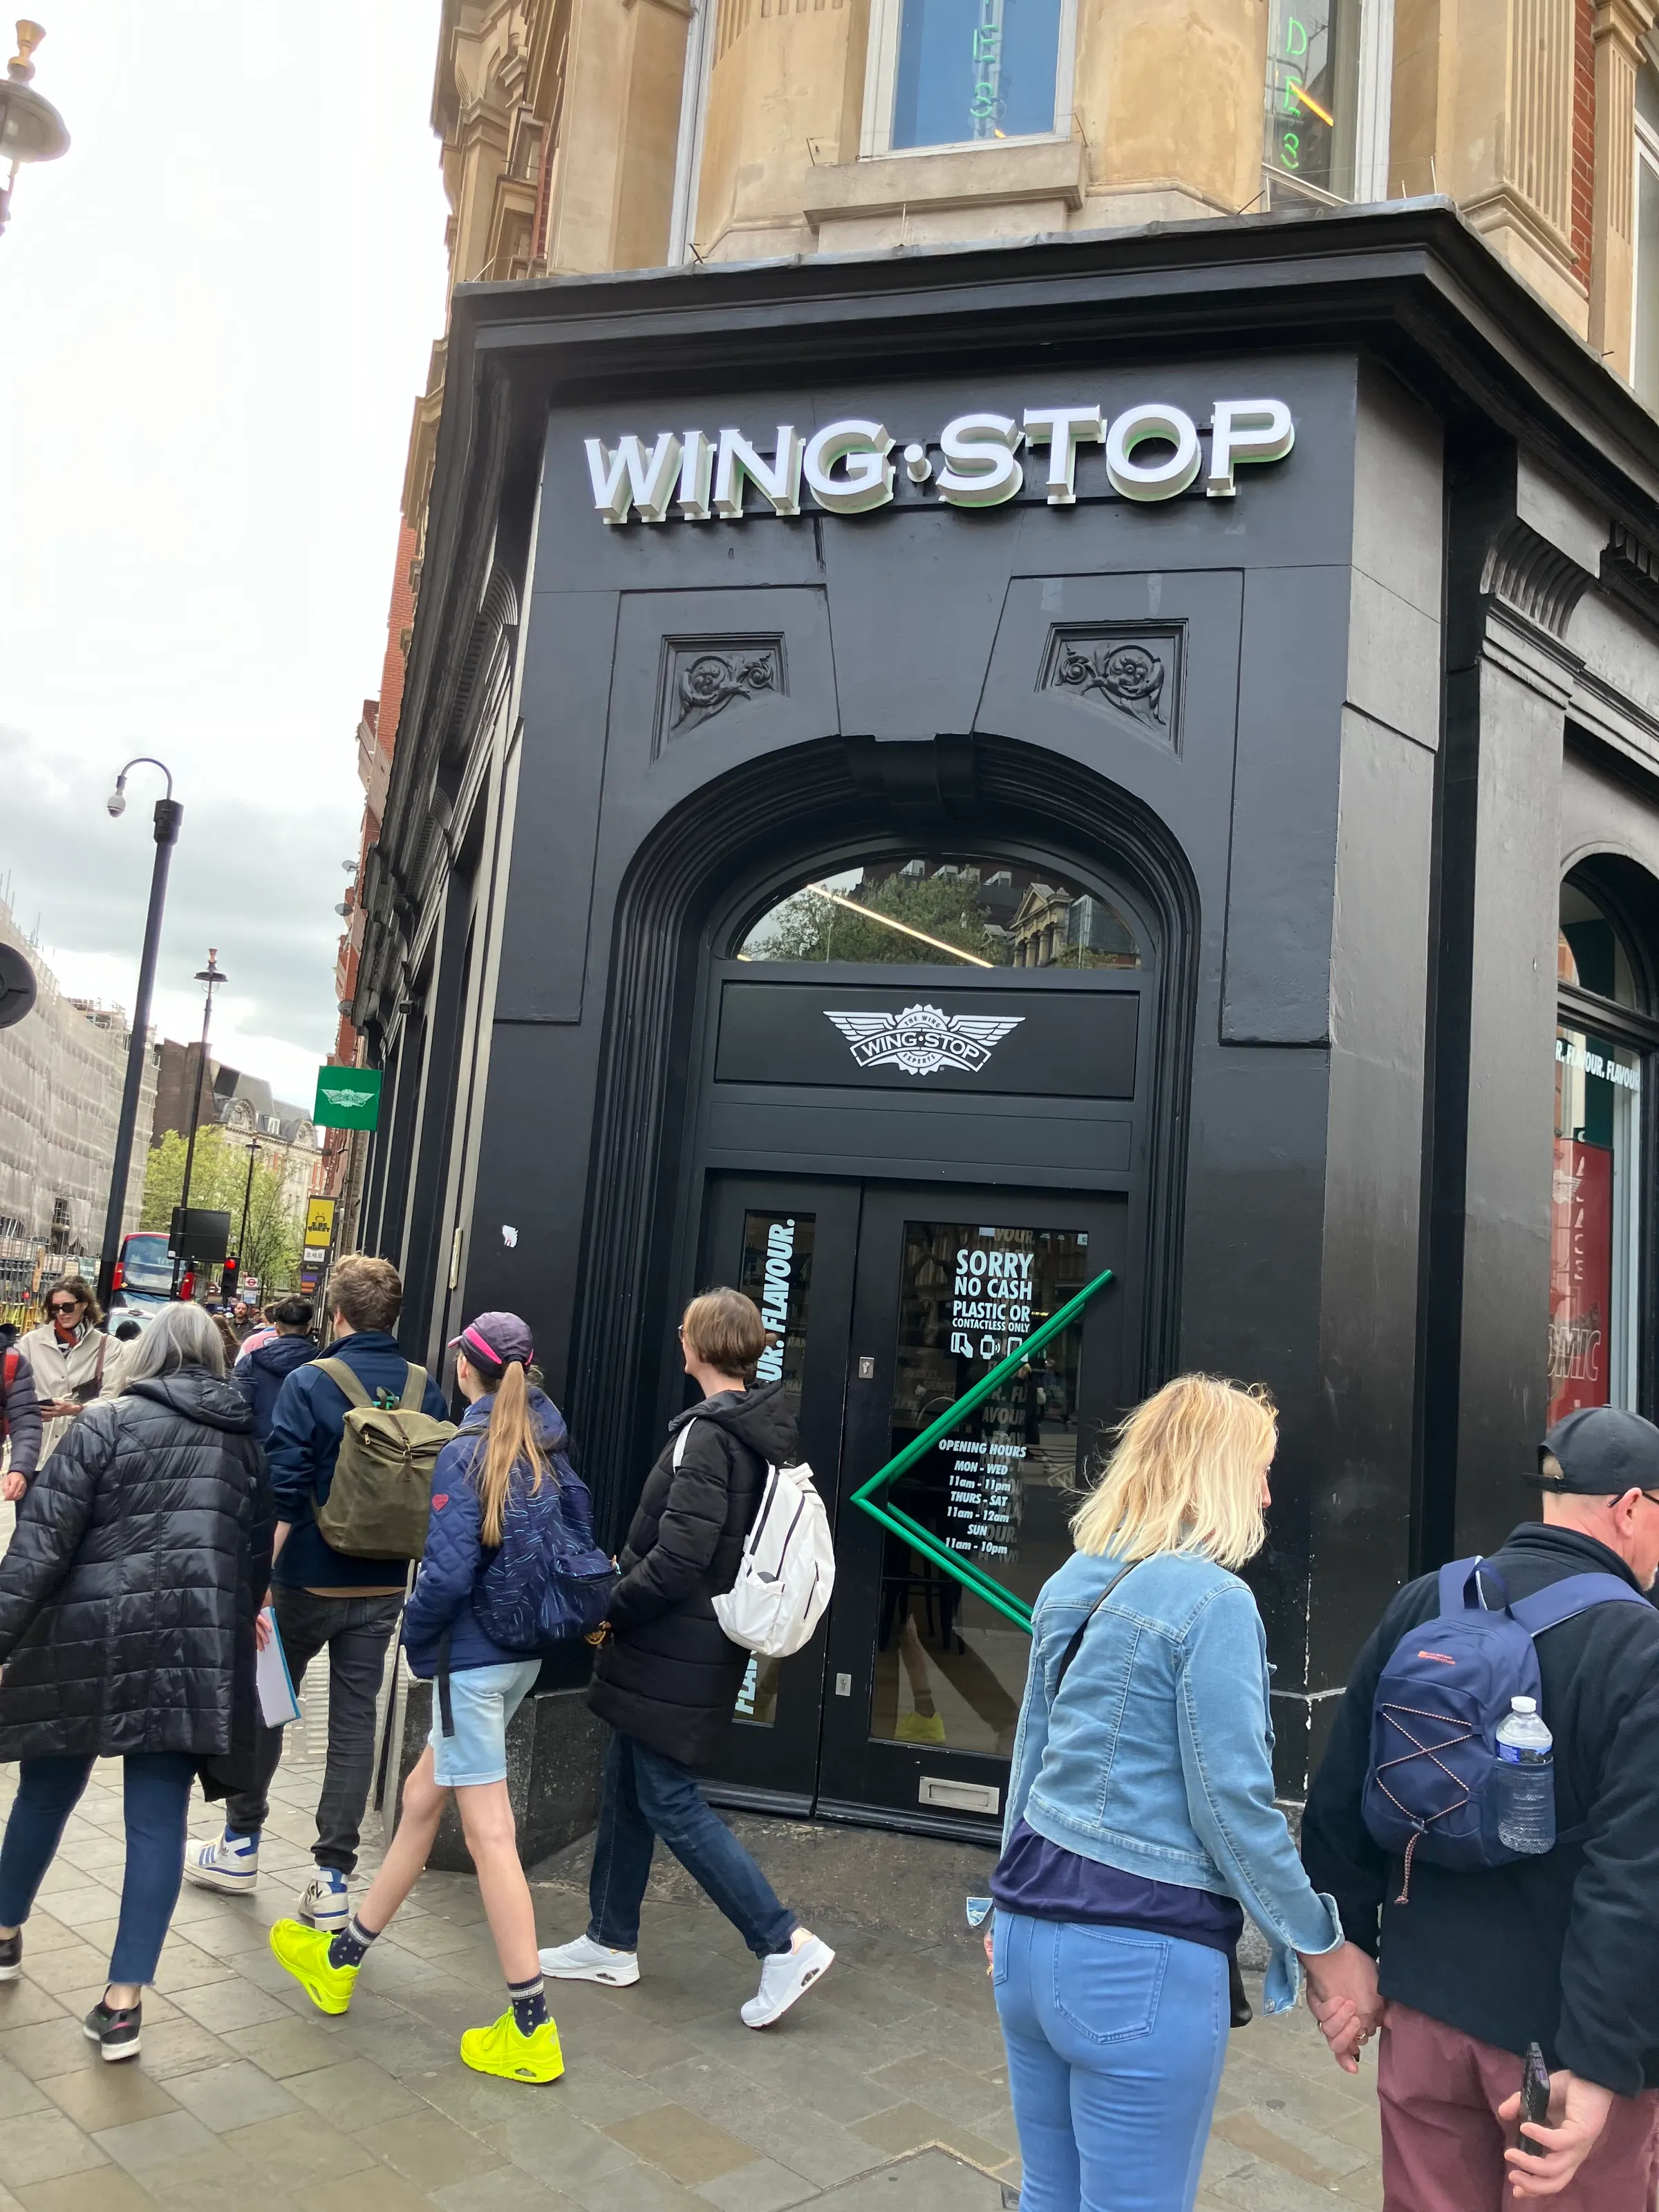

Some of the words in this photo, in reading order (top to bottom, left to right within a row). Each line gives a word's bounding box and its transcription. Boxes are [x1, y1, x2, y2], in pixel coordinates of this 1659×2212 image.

[904, 1015, 918, 1026] THE
[921, 1015, 941, 1028] WING
[903, 1053, 935, 1064] EXPERTS
[956, 1248, 1034, 1279] SORRY
[761, 1219, 796, 1333] FLAVOUR.
[954, 1275, 982, 1297] NO
[987, 1278, 1033, 1301] CASH
[953, 1300, 1006, 1320] PLASTIC
[1009, 1304, 1031, 1322] OR
[952, 1318, 1006, 1331] CONTACTLESS
[1008, 1322, 1031, 1333] ONLY
[938, 1438, 988, 1454] OPENING
[988, 1443, 1027, 1459] HOURS
[954, 1460, 979, 1473] MON
[986, 1463, 1009, 1475] WED
[949, 1474, 975, 1489] 11am
[984, 1479, 1011, 1492] 11pm
[950, 1490, 982, 1504] THURS
[989, 1494, 1009, 1507] SAT
[947, 1506, 973, 1519] 11am
[983, 1509, 1010, 1523] 12am
[966, 1524, 988, 1537] SUN
[945, 1537, 972, 1550] 11am
[981, 1541, 1008, 1555] 10pm
